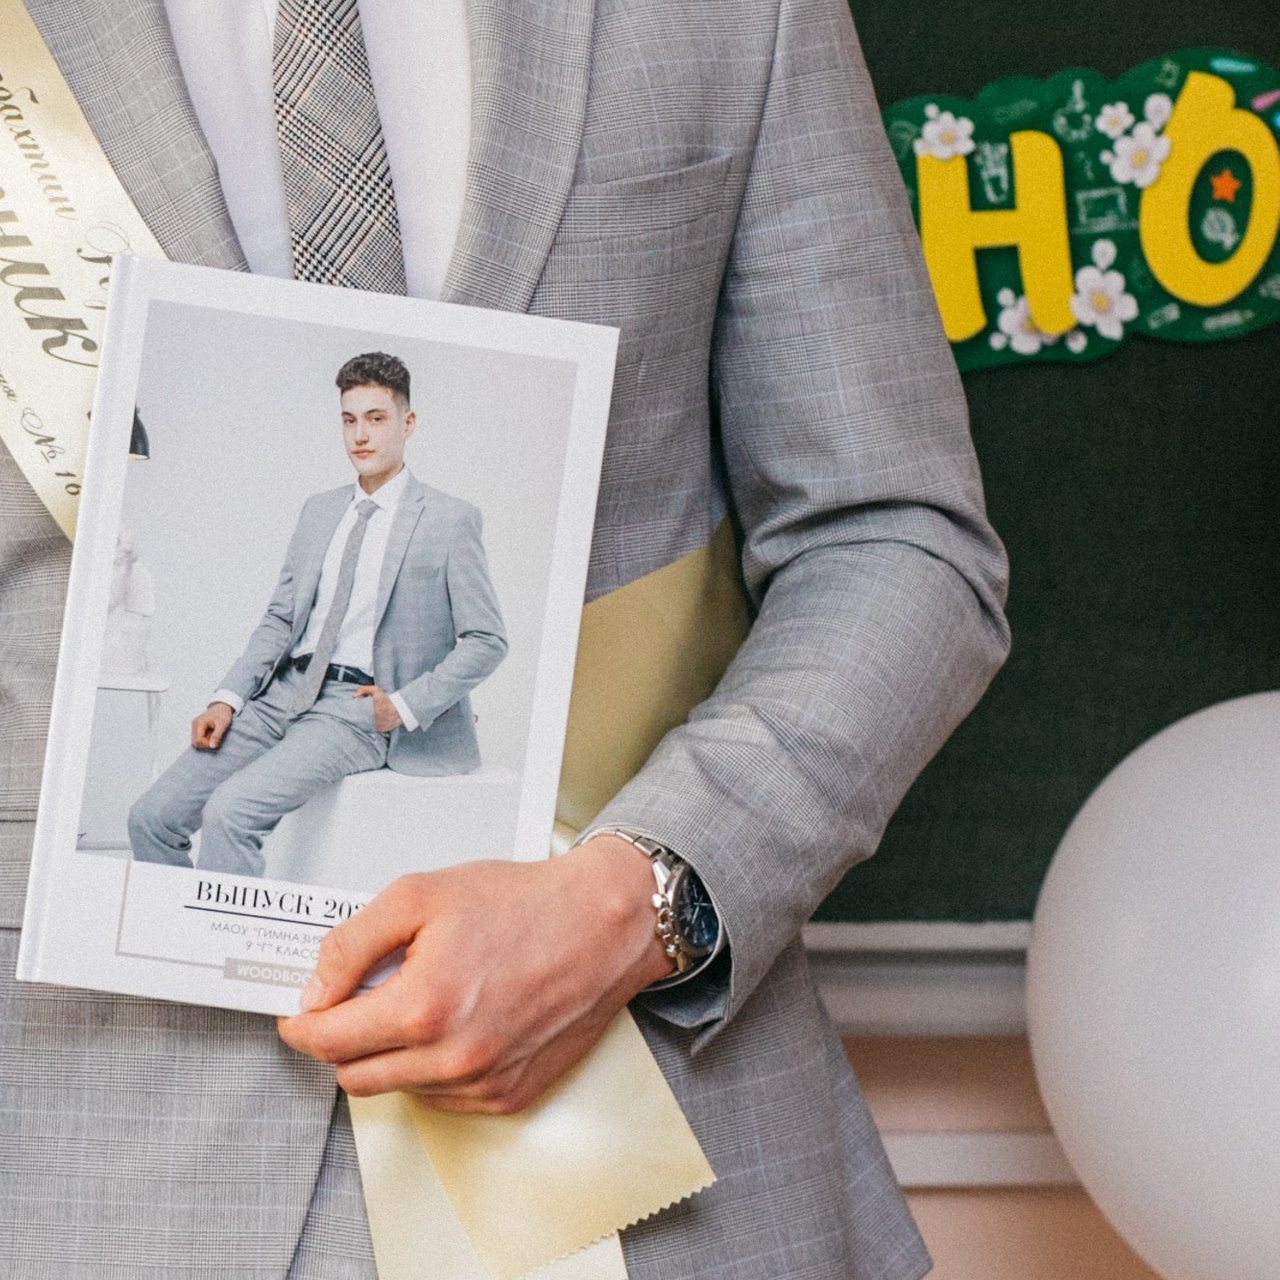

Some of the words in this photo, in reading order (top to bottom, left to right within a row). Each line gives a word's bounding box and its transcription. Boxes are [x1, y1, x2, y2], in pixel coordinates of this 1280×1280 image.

[197, 881, 314, 916] ВЫПУСК
[211, 921, 249, 937] МАОУ
[245, 940, 252, 951] 9
[276, 944, 321, 960] КЛАСС
